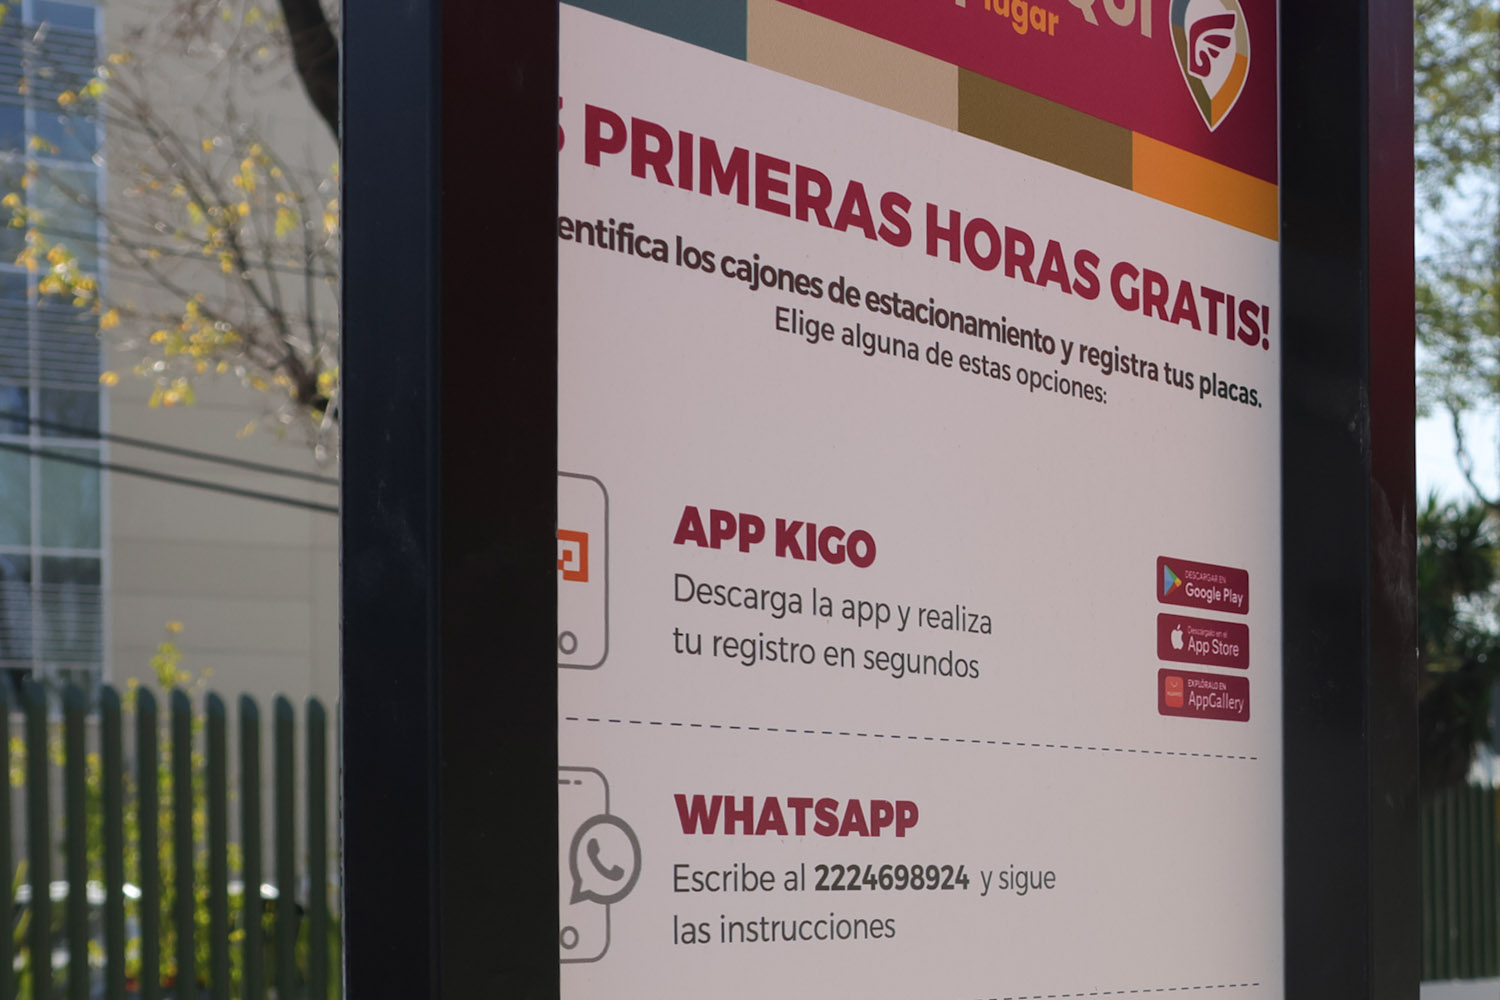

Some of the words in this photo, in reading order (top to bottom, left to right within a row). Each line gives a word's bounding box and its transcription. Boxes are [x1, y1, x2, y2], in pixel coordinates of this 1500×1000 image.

[985, 0, 1059, 36] ugar
[585, 104, 911, 250] PRIMERAS
[926, 203, 1100, 304] HORAS
[1111, 262, 1269, 351] GRATIS!
[676, 236, 715, 273] los
[721, 254, 823, 298] cajones
[828, 276, 860, 307] de
[864, 290, 1056, 358] estacionamiento
[1061, 339, 1073, 365] y
[1080, 344, 1158, 381] registra
[1164, 363, 1194, 390] tus
[1200, 373, 1261, 408] placas.
[776, 306, 834, 344] Elige
[842, 323, 918, 361] alguna
[926, 342, 953, 367] de
[959, 355, 1011, 381] estas
[1017, 368, 1106, 404] opciones:
[673, 506, 765, 553] APP
[776, 518, 876, 568] KIGO
[675, 574, 802, 619] Descarga
[813, 588, 832, 617] la
[842, 600, 890, 629] app
[898, 605, 910, 631] y
[919, 605, 991, 634] realiza
[1185, 582, 1221, 604] Google
[1223, 588, 1244, 608] Play
[673, 628, 701, 655] tu
[714, 633, 815, 666] registro
[824, 647, 854, 668] en
[864, 650, 979, 678] segundos
[1188, 636, 1210, 656] App
[1211, 638, 1240, 657] Store
[1188, 690, 1244, 713] AppGallery
[674, 794, 918, 837] WHATSAPP
[674, 863, 775, 892] Escribe
[784, 863, 804, 891] al
[815, 864, 969, 891] 2224698924
[981, 871, 992, 896] y
[999, 864, 1055, 896] sigue
[674, 915, 710, 944] las
[721, 913, 895, 943] instrucciones
